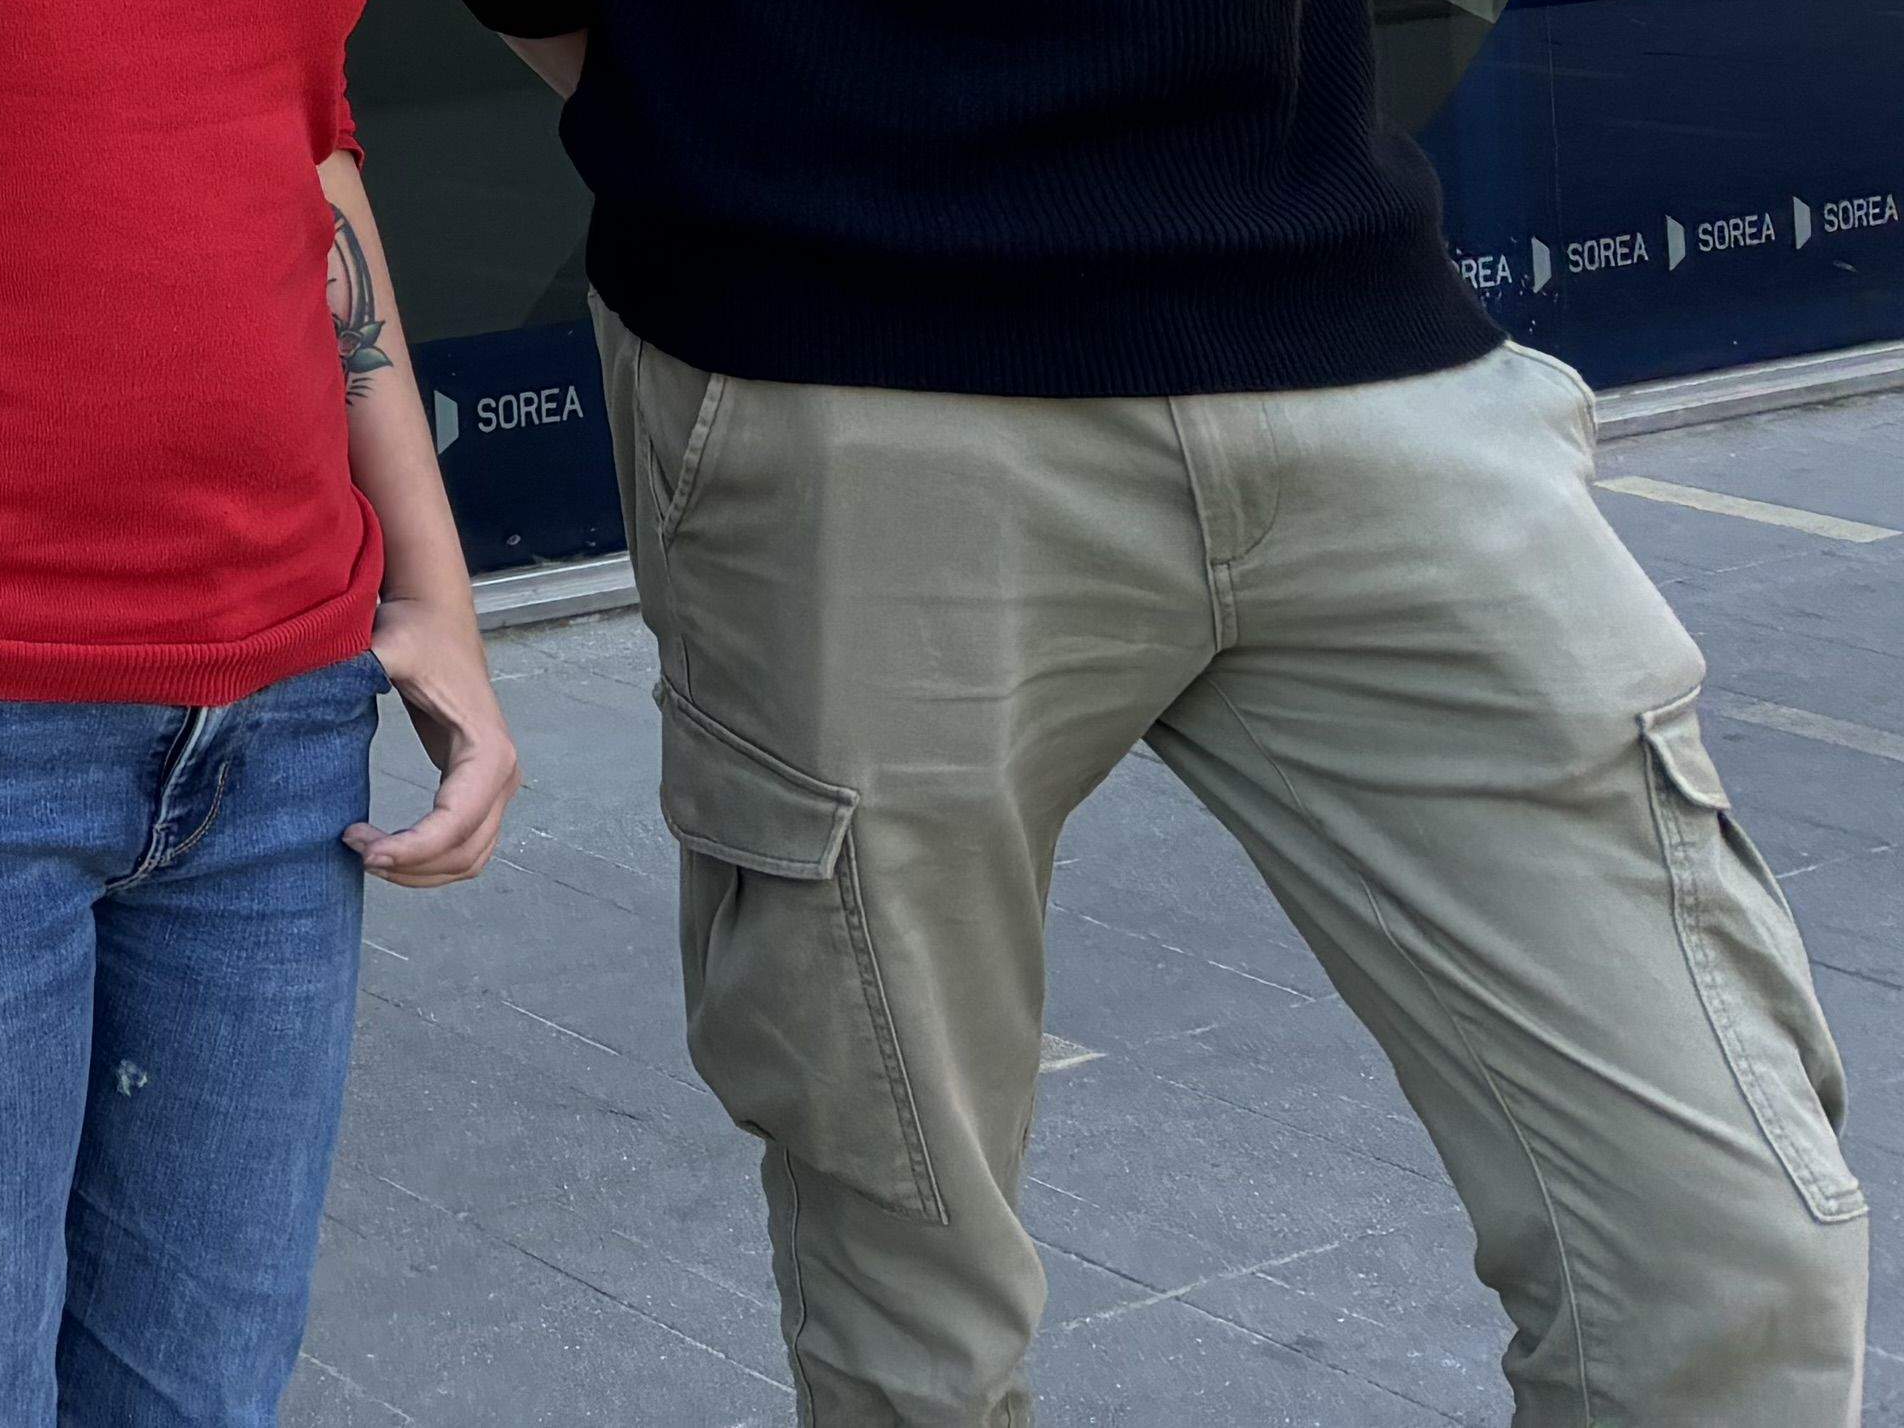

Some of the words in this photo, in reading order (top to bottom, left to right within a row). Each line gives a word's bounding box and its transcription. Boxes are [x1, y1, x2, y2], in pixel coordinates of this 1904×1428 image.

[1452, 254, 1513, 289] REA
[1568, 232, 1649, 273] SOREA
[1698, 213, 1775, 252] SOREA
[1824, 194, 1899, 232] SOREA
[477, 385, 584, 434] SOREA
